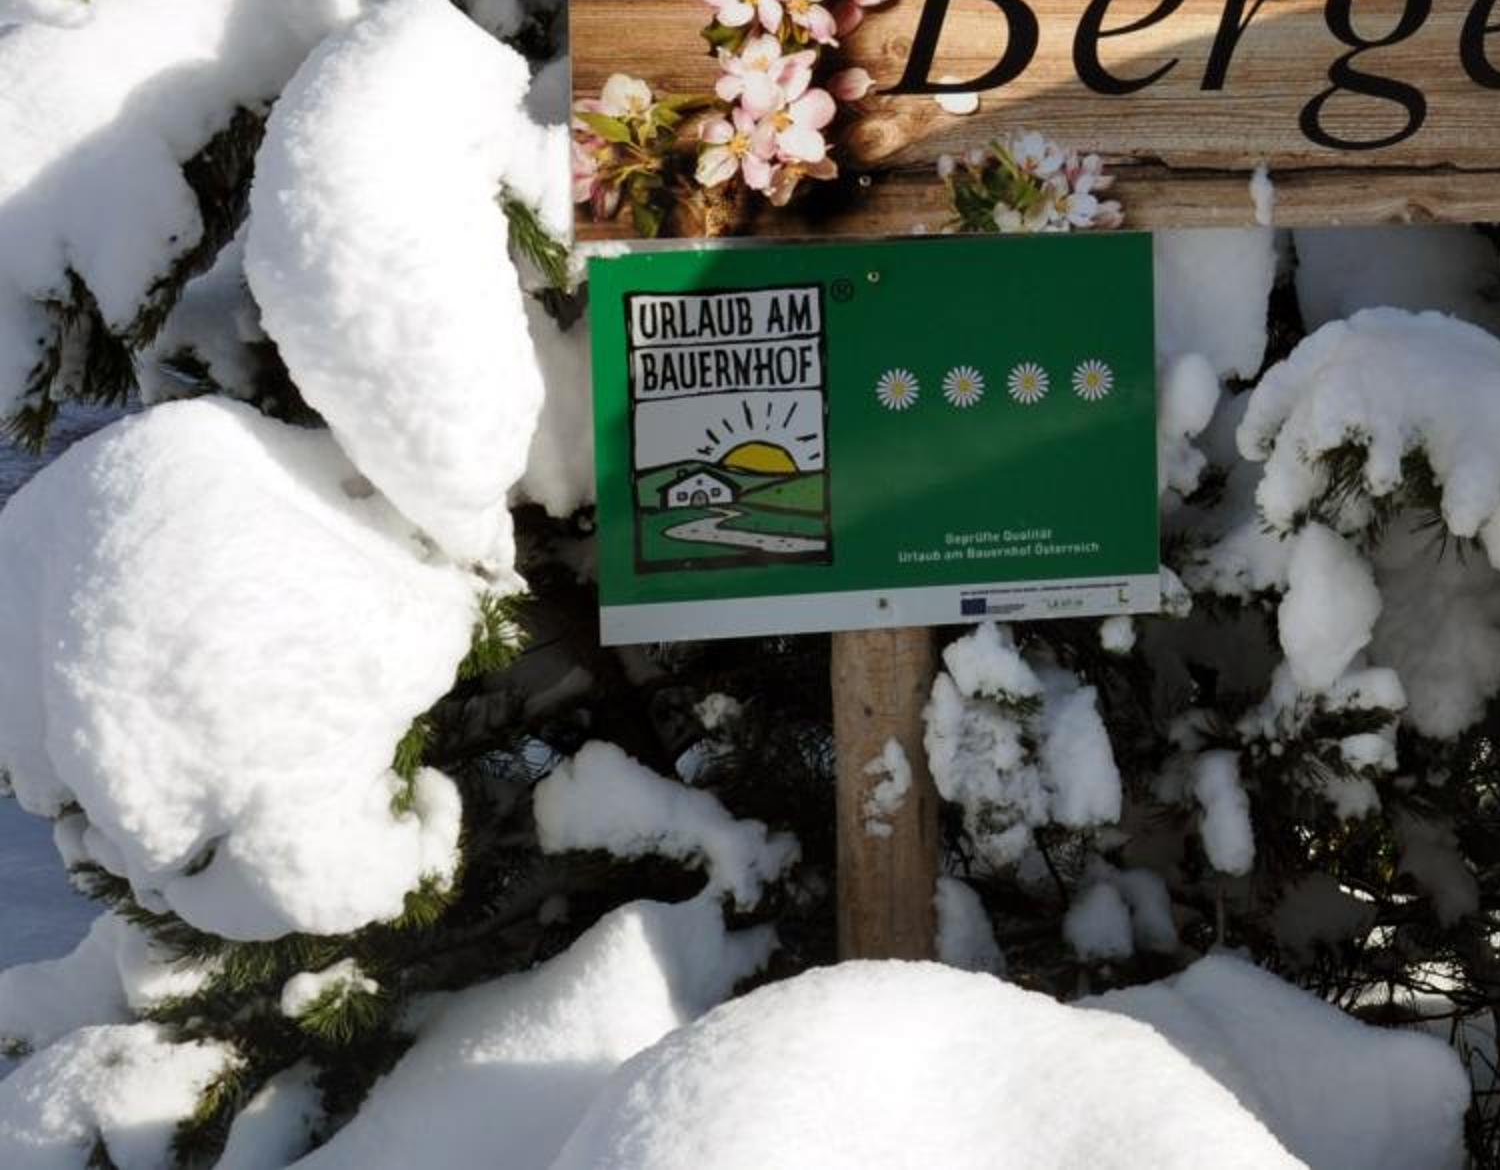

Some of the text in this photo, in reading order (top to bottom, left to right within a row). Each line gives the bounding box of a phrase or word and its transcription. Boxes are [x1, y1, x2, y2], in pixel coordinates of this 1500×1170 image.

[639, 293, 813, 339] URLAUB AM
[641, 345, 813, 391] BAUERNHOF
[1003, 528, 1053, 541] Qualität
[898, 541, 1100, 562] Urlaub am Bauernhof Österreich
